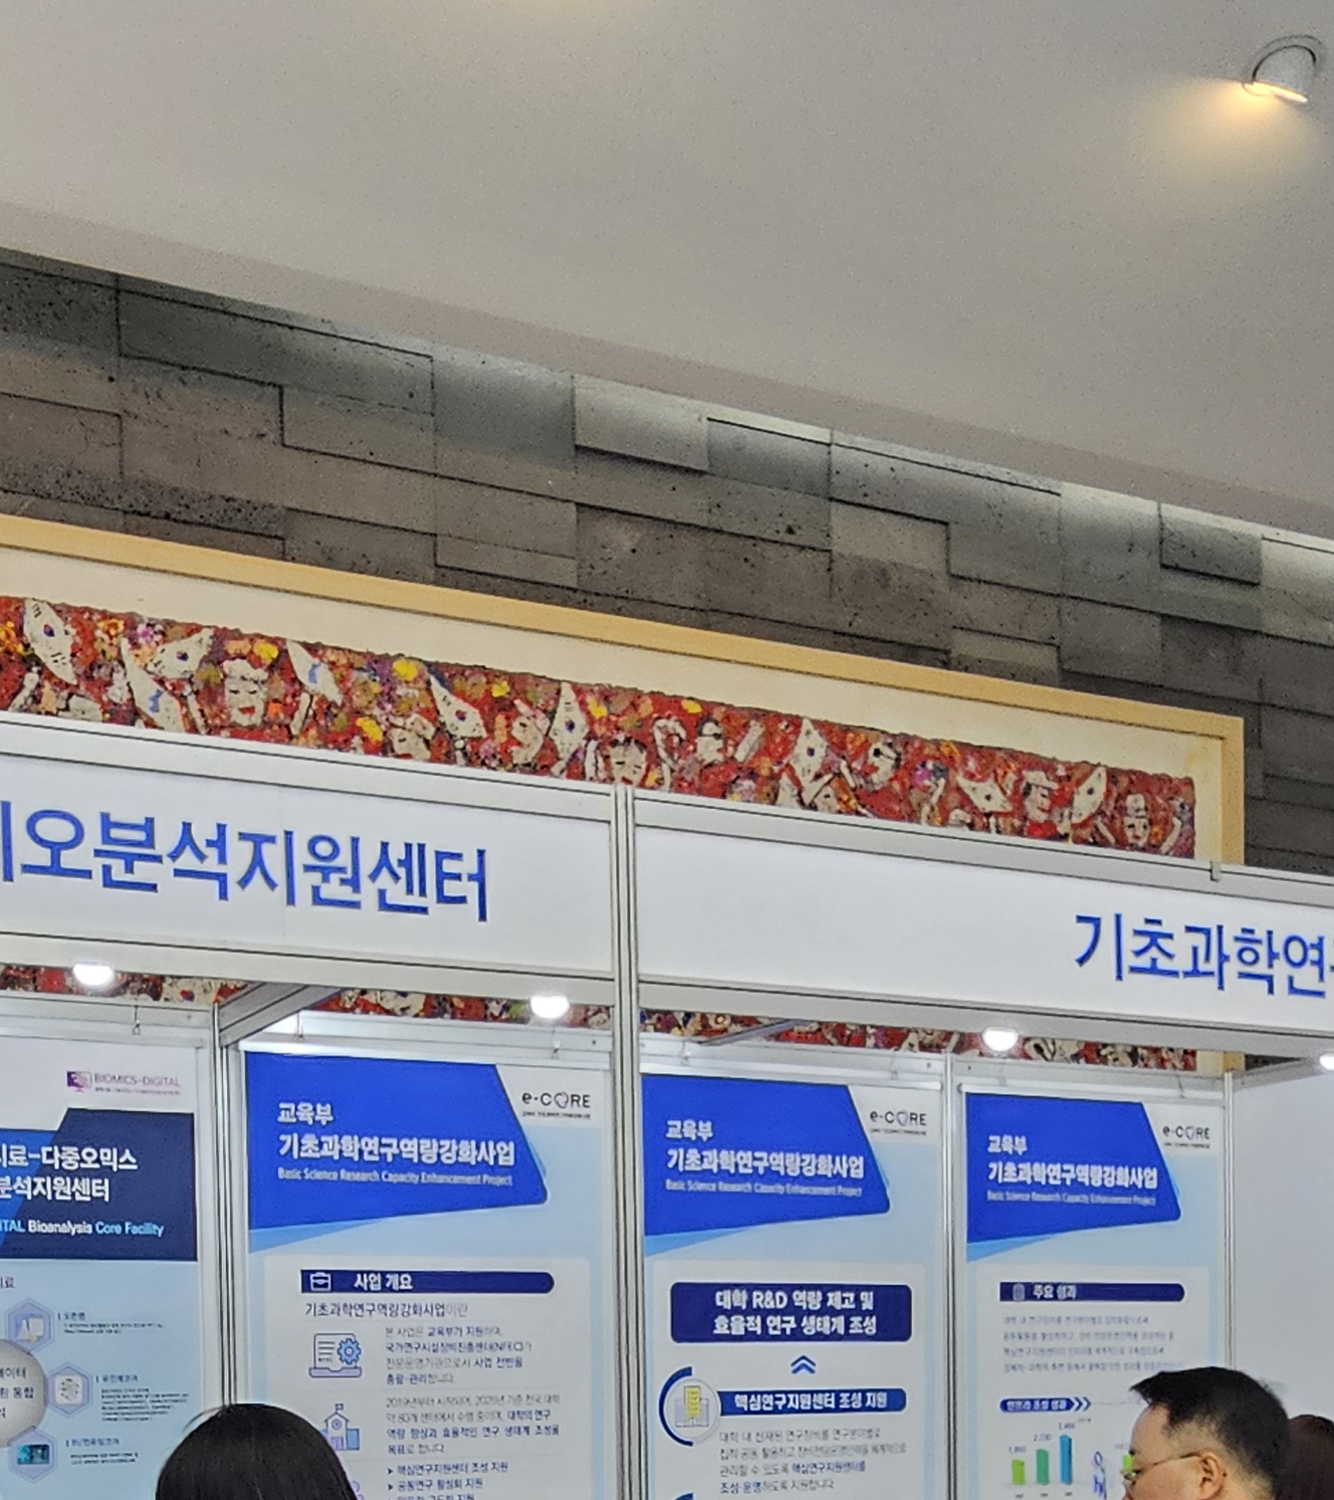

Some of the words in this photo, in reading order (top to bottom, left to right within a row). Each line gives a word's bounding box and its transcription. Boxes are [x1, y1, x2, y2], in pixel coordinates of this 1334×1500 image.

[277, 1102, 334, 1126] 교육부
[666, 1119, 713, 1141] 교육부
[279, 1133, 515, 1166] 기초과학연구역량강화사업
[987, 1134, 1028, 1155] 교육부
[667, 1148, 864, 1179] 기초과학연구역량강화사업
[988, 1161, 1158, 1189] 기초과학연구역량강화사업
[28, 1220, 93, 1236] Bioanalysis
[95, 1221, 122, 1235] Core
[125, 1222, 164, 1238] Facility
[354, 1273, 381, 1291] 사업
[385, 1274, 413, 1290] 개요
[715, 1289, 747, 1310] 대학
[752, 1290, 788, 1310] R&D
[792, 1290, 823, 1311] 역량
[827, 1290, 855, 1310] 제고
[860, 1290, 874, 1311] 및
[713, 1315, 762, 1335] 효율적
[767, 1316, 797, 1335] 연구
[801, 1316, 845, 1335] 생태계
[849, 1316, 877, 1335] 조성
